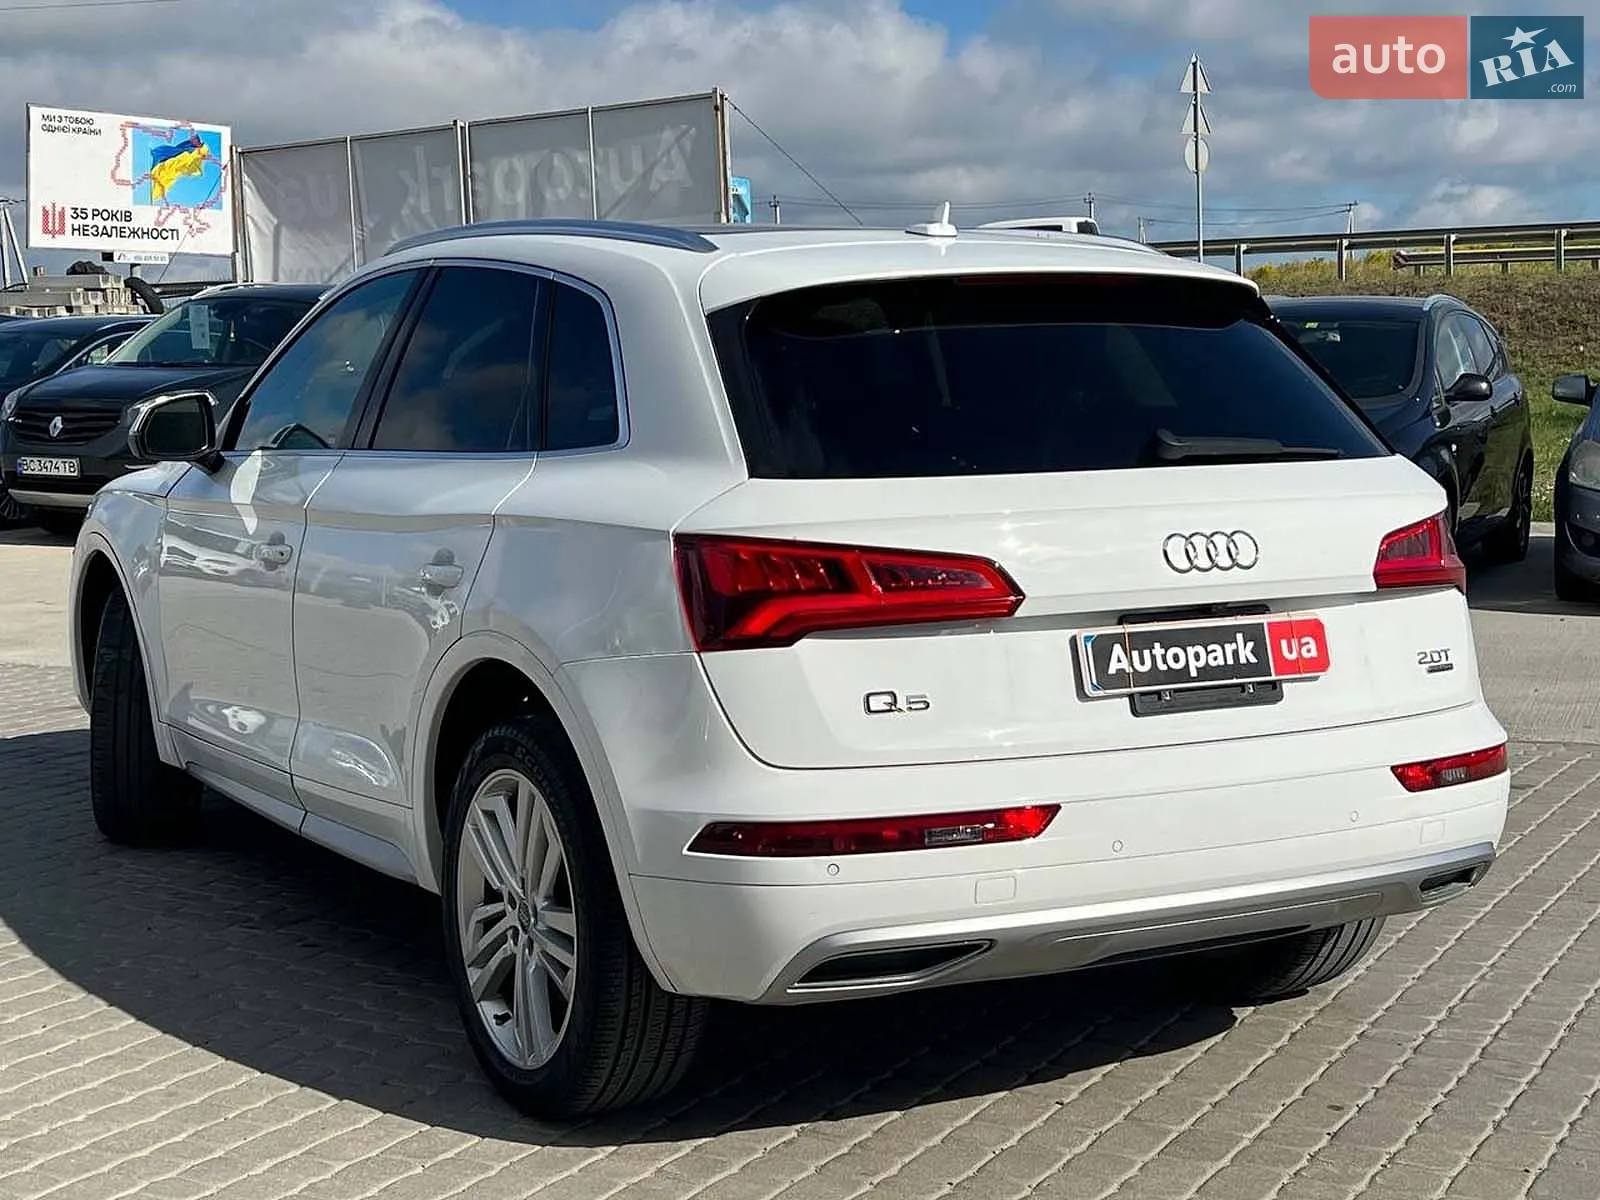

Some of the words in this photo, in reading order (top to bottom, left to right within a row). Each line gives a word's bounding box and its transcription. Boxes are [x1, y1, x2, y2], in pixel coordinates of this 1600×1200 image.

[41, 113, 56, 123] МИ
[64, 115, 95, 126] ТОБОЮ
[41, 123, 71, 134] ОДНІЄЇ
[72, 126, 102, 136] КРАЇНИ
[70, 207, 89, 220] 35
[91, 208, 133, 223] РОКІВ
[71, 223, 180, 241] НЕЗАЛЕЖНОСТІ
[1107, 631, 1259, 677] Autopark
[863, 690, 931, 715] Q5
